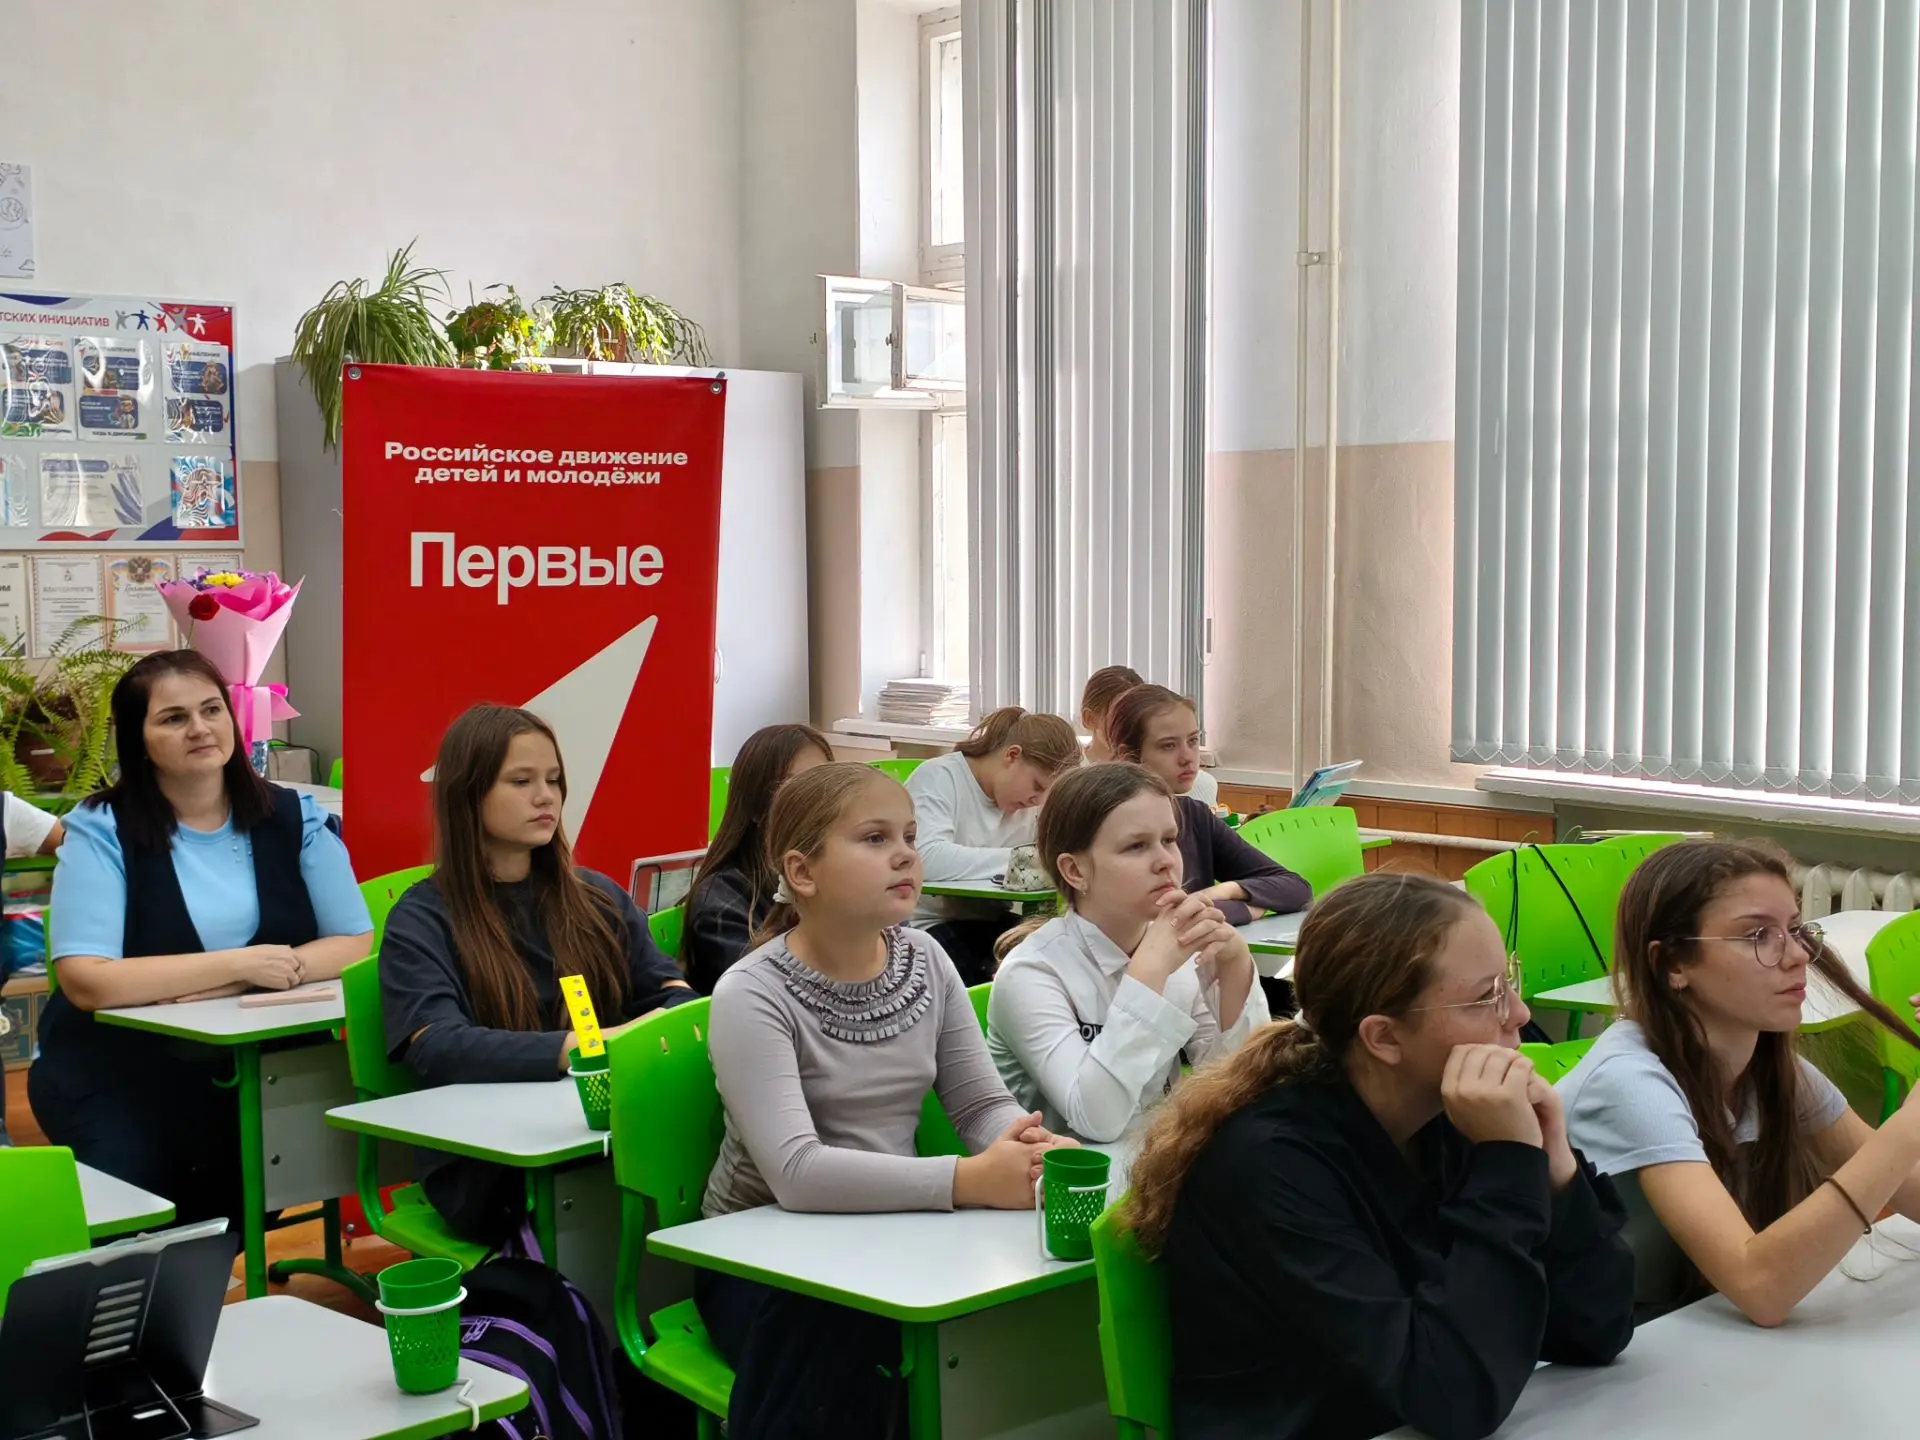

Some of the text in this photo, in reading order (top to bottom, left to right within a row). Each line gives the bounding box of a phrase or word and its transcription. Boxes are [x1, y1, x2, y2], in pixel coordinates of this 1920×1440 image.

[39, 314, 110, 327] ИНИЦИАТИВ
[384, 441, 688, 466] Российское движение
[415, 464, 661, 487] детей и молодёжи
[410, 532, 664, 605] Первые
